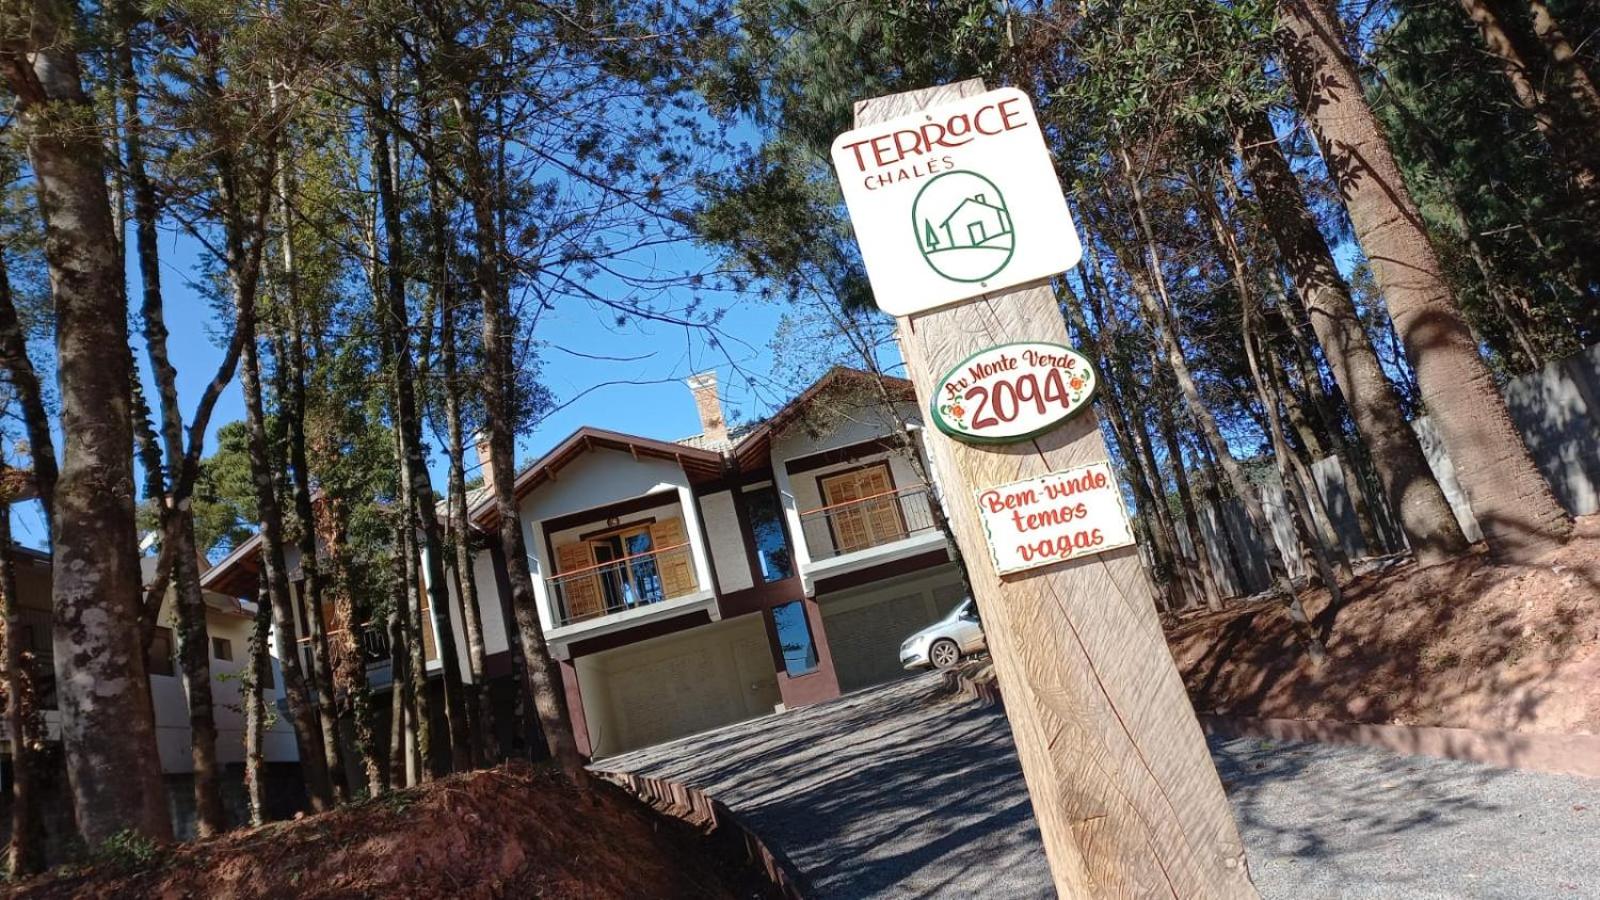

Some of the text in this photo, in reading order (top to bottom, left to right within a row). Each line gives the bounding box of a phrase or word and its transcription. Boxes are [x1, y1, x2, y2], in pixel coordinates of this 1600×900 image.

[944, 349, 1076, 400] Av Monte Verde
[964, 368, 1070, 430] 2094
[1012, 502, 1088, 533] temos
[1016, 528, 1104, 562] vagas
